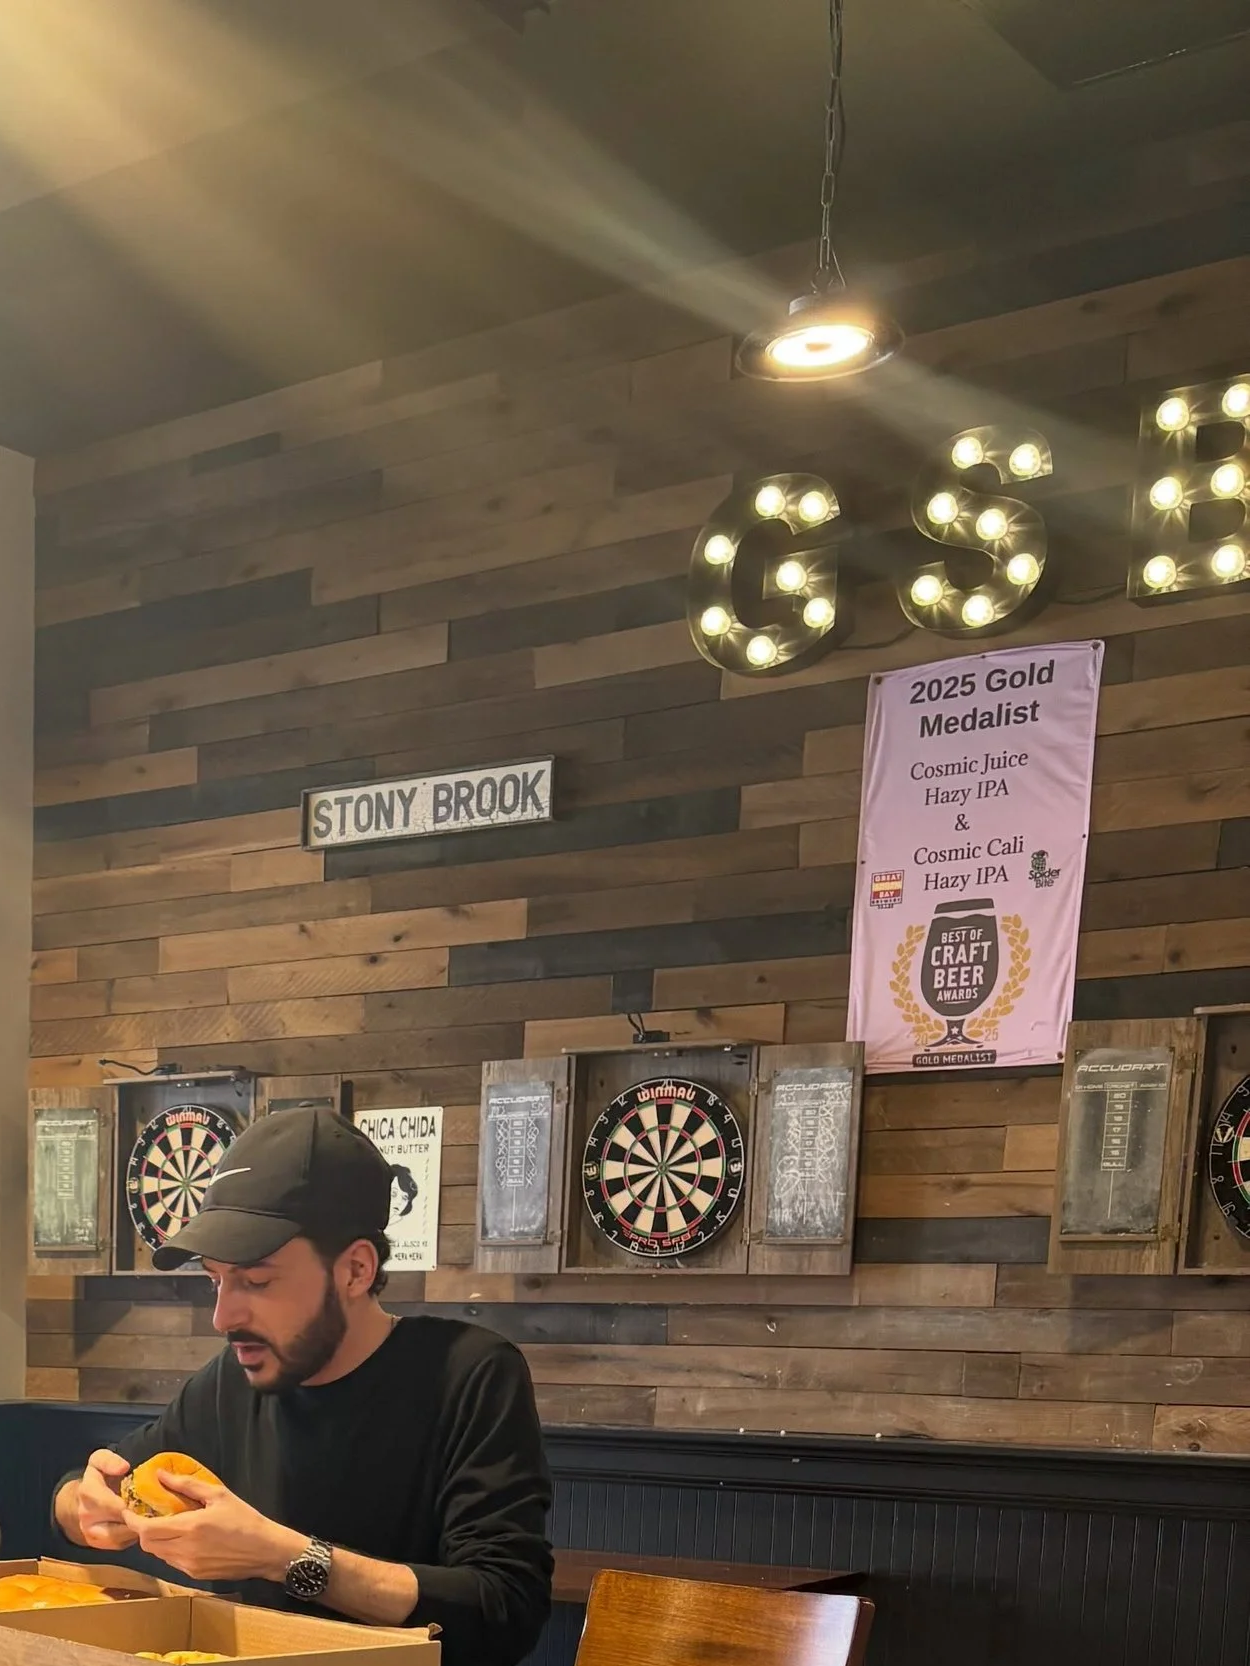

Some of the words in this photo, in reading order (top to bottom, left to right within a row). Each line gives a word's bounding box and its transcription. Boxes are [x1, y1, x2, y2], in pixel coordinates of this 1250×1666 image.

[909, 673, 976, 704] 2025
[985, 659, 1055, 692] Gold
[919, 700, 1040, 738] Medalist
[910, 756, 978, 780] Cosmic
[980, 751, 1028, 775] Juice
[313, 787, 417, 838] STONY
[432, 769, 546, 824] BROOK
[924, 787, 972, 806] Hazy
[976, 778, 1009, 799] IPA
[954, 813, 970, 831] &
[914, 842, 981, 865] Cosmic
[987, 836, 1024, 857] Cali
[875, 874, 901, 882] GREAT
[924, 873, 971, 892] Hazy
[976, 865, 1009, 885] IPA
[1028, 868, 1061, 881] Spider
[941, 930, 967, 944] BEST
[970, 929, 984, 941] OF
[931, 941, 992, 966] CRAFT
[934, 965, 984, 989] BEER
[937, 987, 978, 1002] AWARDS
[914, 1033, 928, 1046] 20
[916, 1056, 940, 1065] GOLD
[943, 1053, 993, 1064] MEDALIST
[1076, 1063, 1168, 1072] ACCUDART
[359, 1117, 395, 1140] CHICA
[400, 1116, 436, 1139] CHIDA
[379, 1145, 395, 1155] NUT
[397, 1143, 430, 1153] BUTTER
